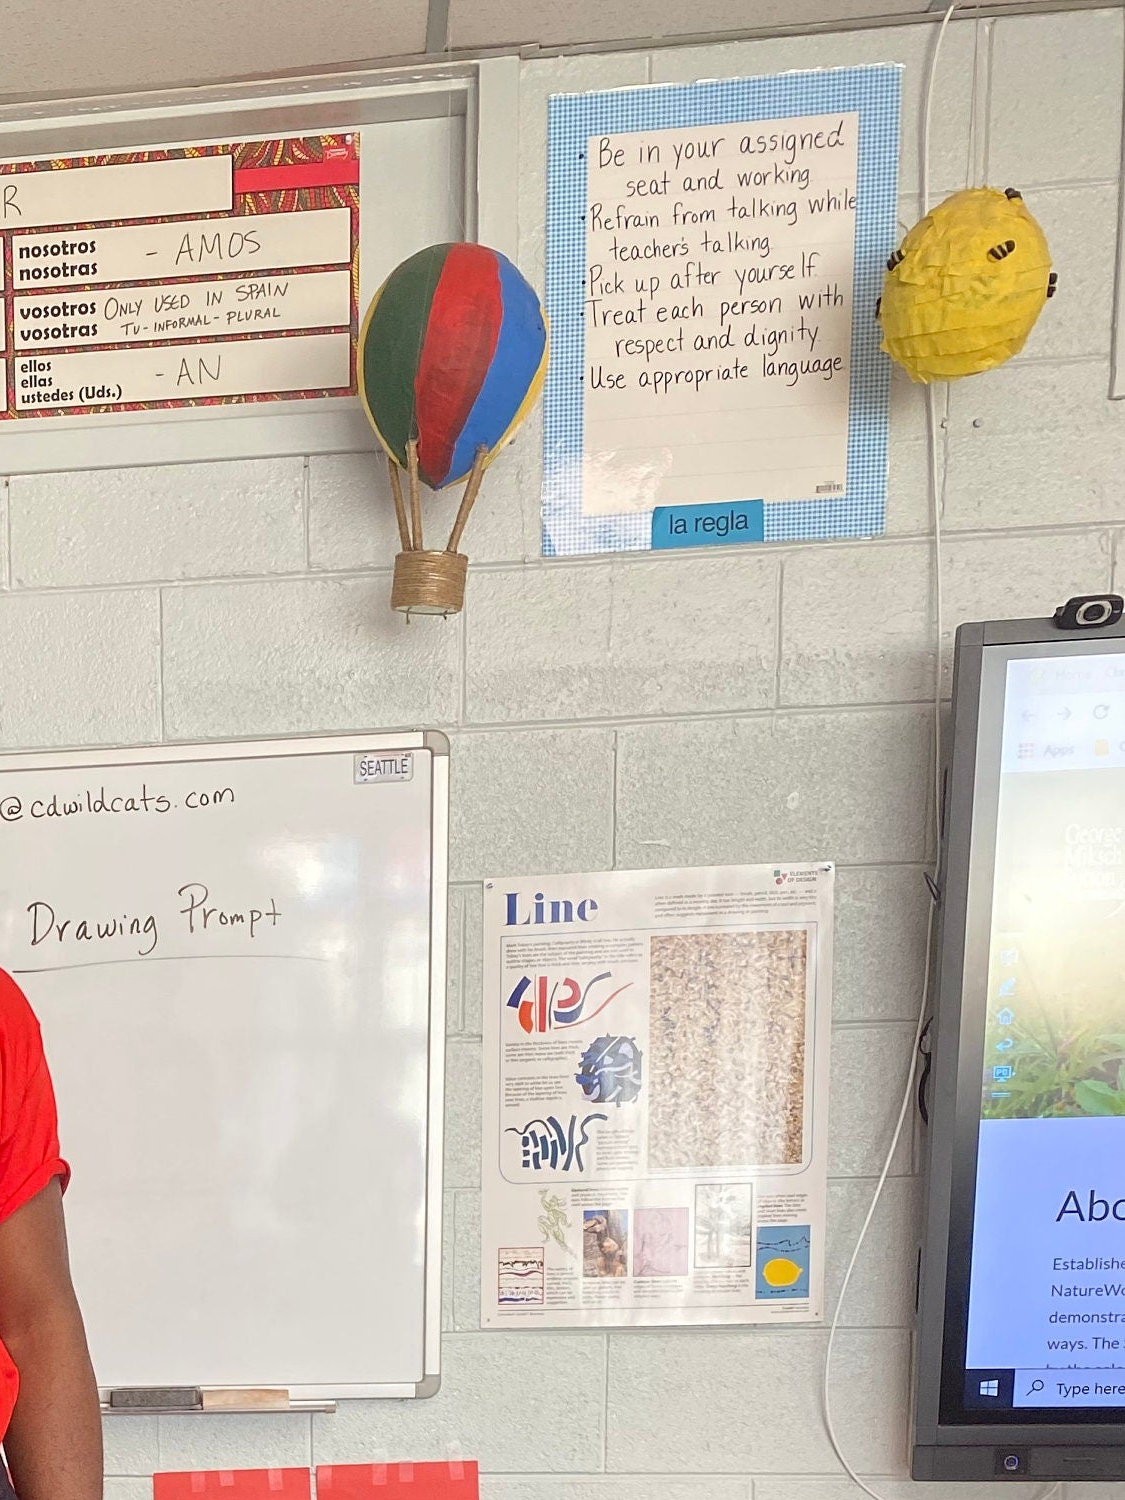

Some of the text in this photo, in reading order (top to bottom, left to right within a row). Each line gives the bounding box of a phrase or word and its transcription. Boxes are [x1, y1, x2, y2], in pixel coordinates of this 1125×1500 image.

[599, 120, 845, 170] Be in your assigned
[626, 163, 810, 198] seat and working
[590, 189, 857, 232] Refrain from talking while
[19, 240, 96, 260] nosotros
[701, 231, 770, 257] talking
[19, 262, 98, 281] nosotras
[590, 265, 625, 297] Pick
[636, 277, 660, 300] up
[671, 262, 721, 288] after
[20, 302, 97, 320] vosotros
[104, 282, 288, 321] ONLY USED IN SPAIN
[585, 283, 844, 327] Treat each person with
[20, 323, 98, 341] vosotras
[615, 327, 683, 362] respect
[694, 324, 734, 350] and
[20, 360, 52, 373] ellos
[591, 354, 843, 394] Use appropriate language
[20, 375, 53, 388] ellas
[21, 384, 122, 404] ustedes (Uds.)
[669, 510, 749, 537] la regla
[360, 759, 408, 776] SEATTLE
[27, 882, 282, 955] Drawing Prompt
[504, 892, 599, 926] Line
[1048, 1337, 1120, 1352] ways. The
[1057, 1383, 1090, 1398] Type
